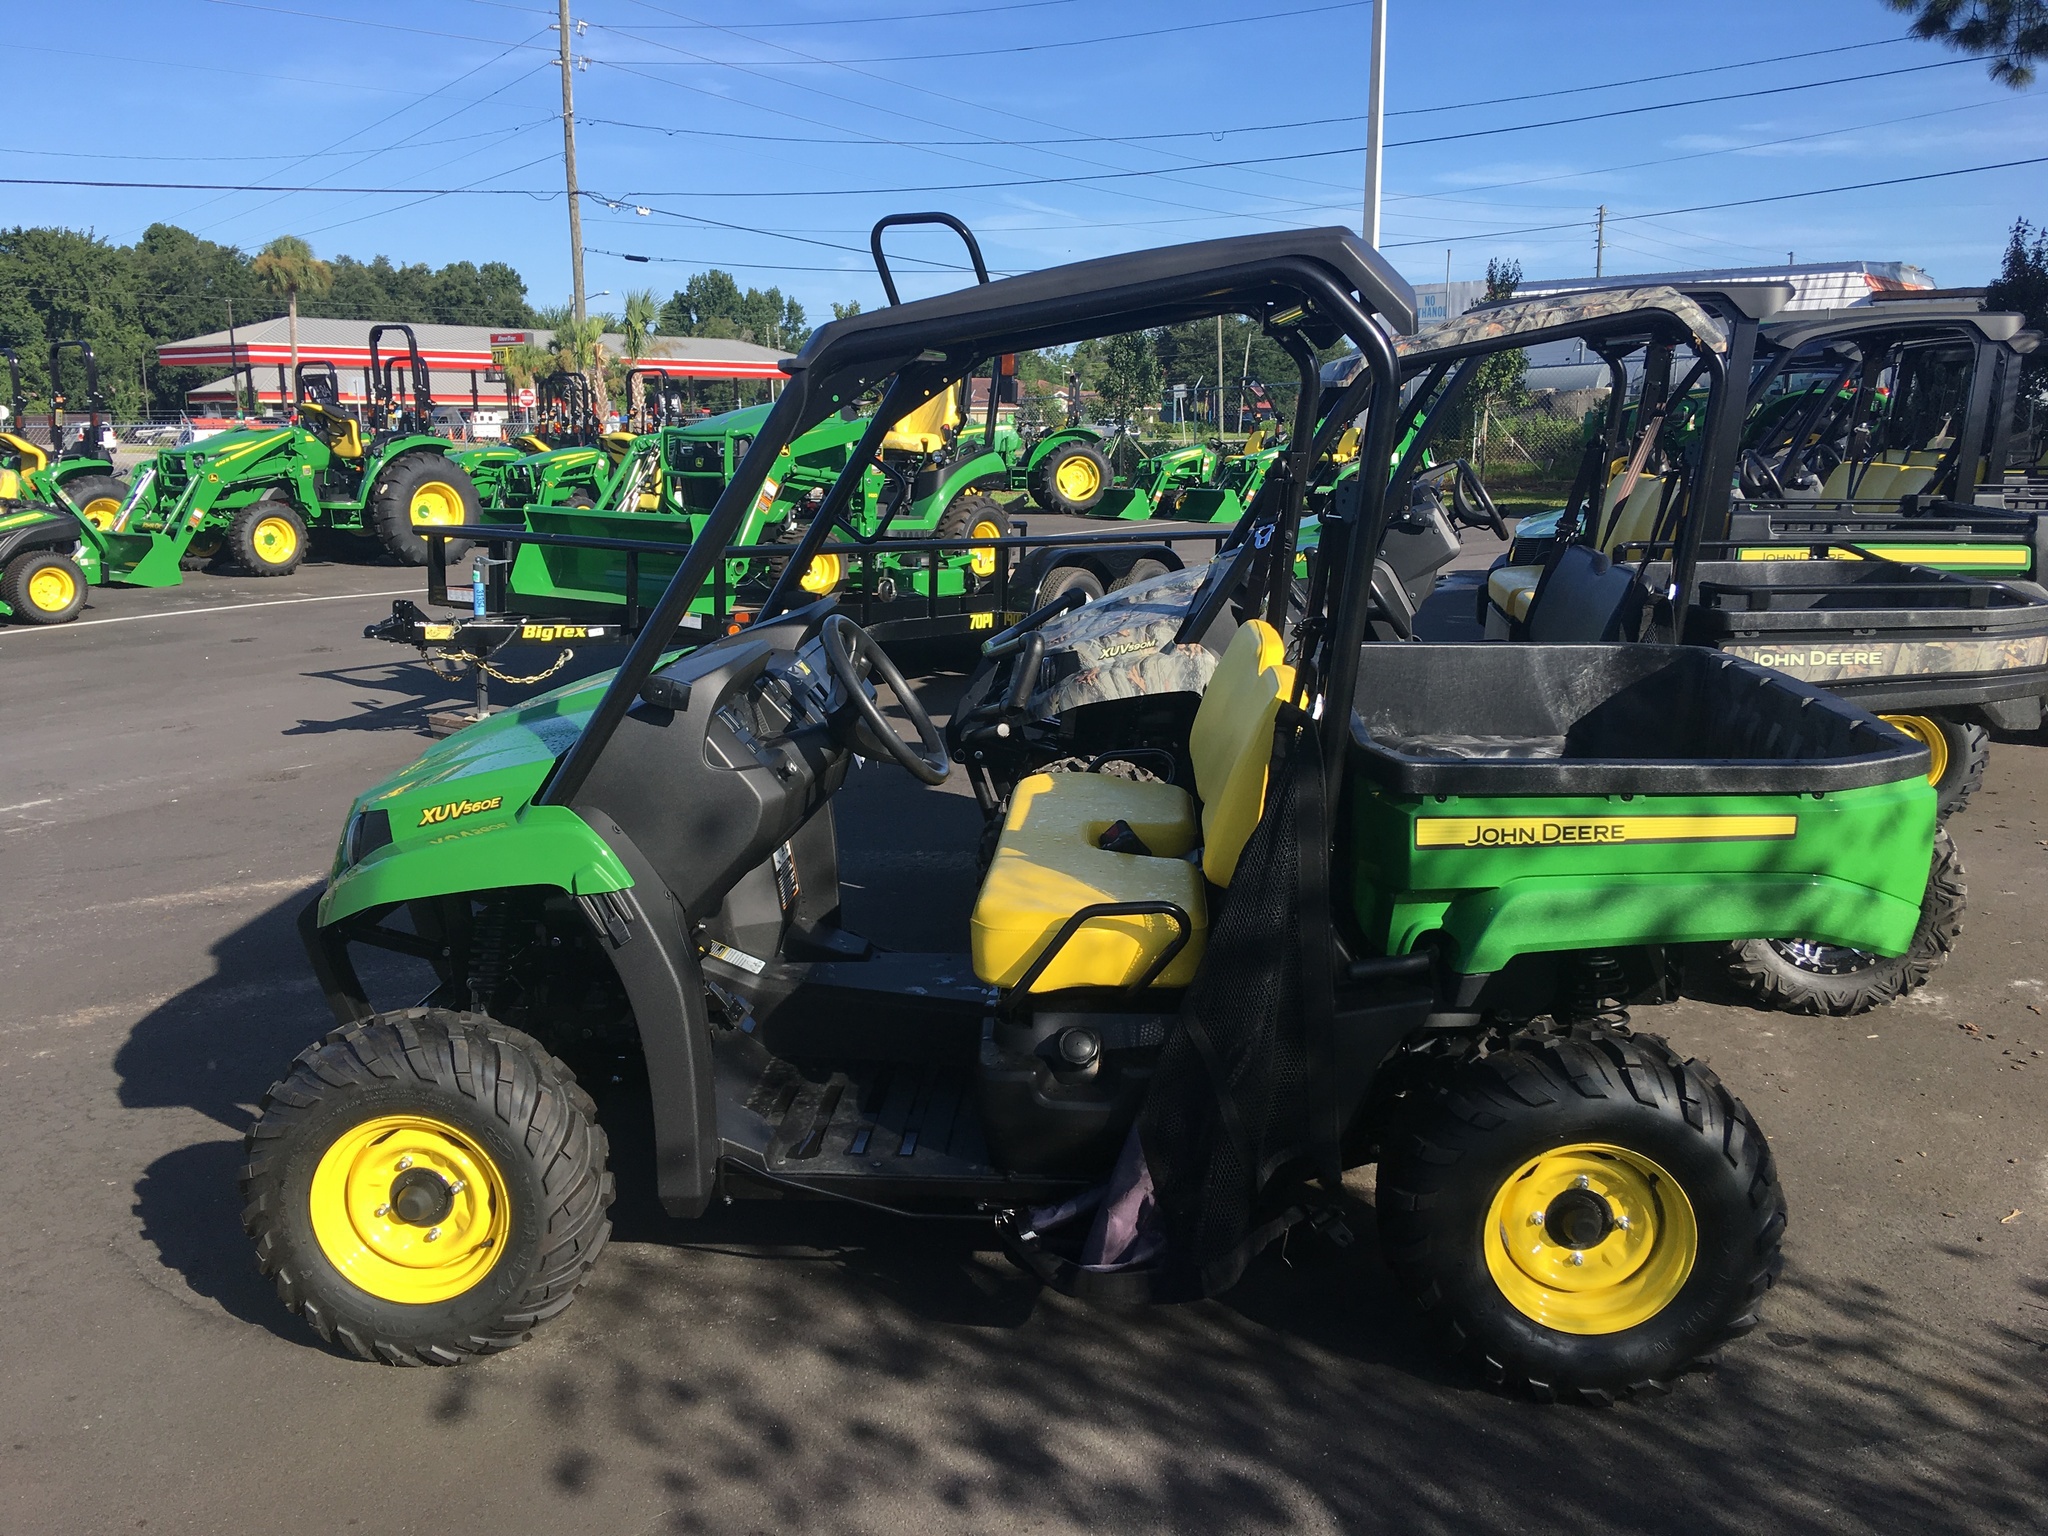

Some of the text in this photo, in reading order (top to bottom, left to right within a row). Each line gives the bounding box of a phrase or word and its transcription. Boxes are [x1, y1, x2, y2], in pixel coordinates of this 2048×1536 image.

[1425, 295, 1436, 306] NO
[1417, 306, 1447, 318] THANOL
[1098, 639, 1158, 661] XUV590M
[1753, 651, 1883, 667] JOHN DEERE
[417, 796, 503, 828] XUV560E
[1467, 823, 1626, 844] JOHN DEERE
